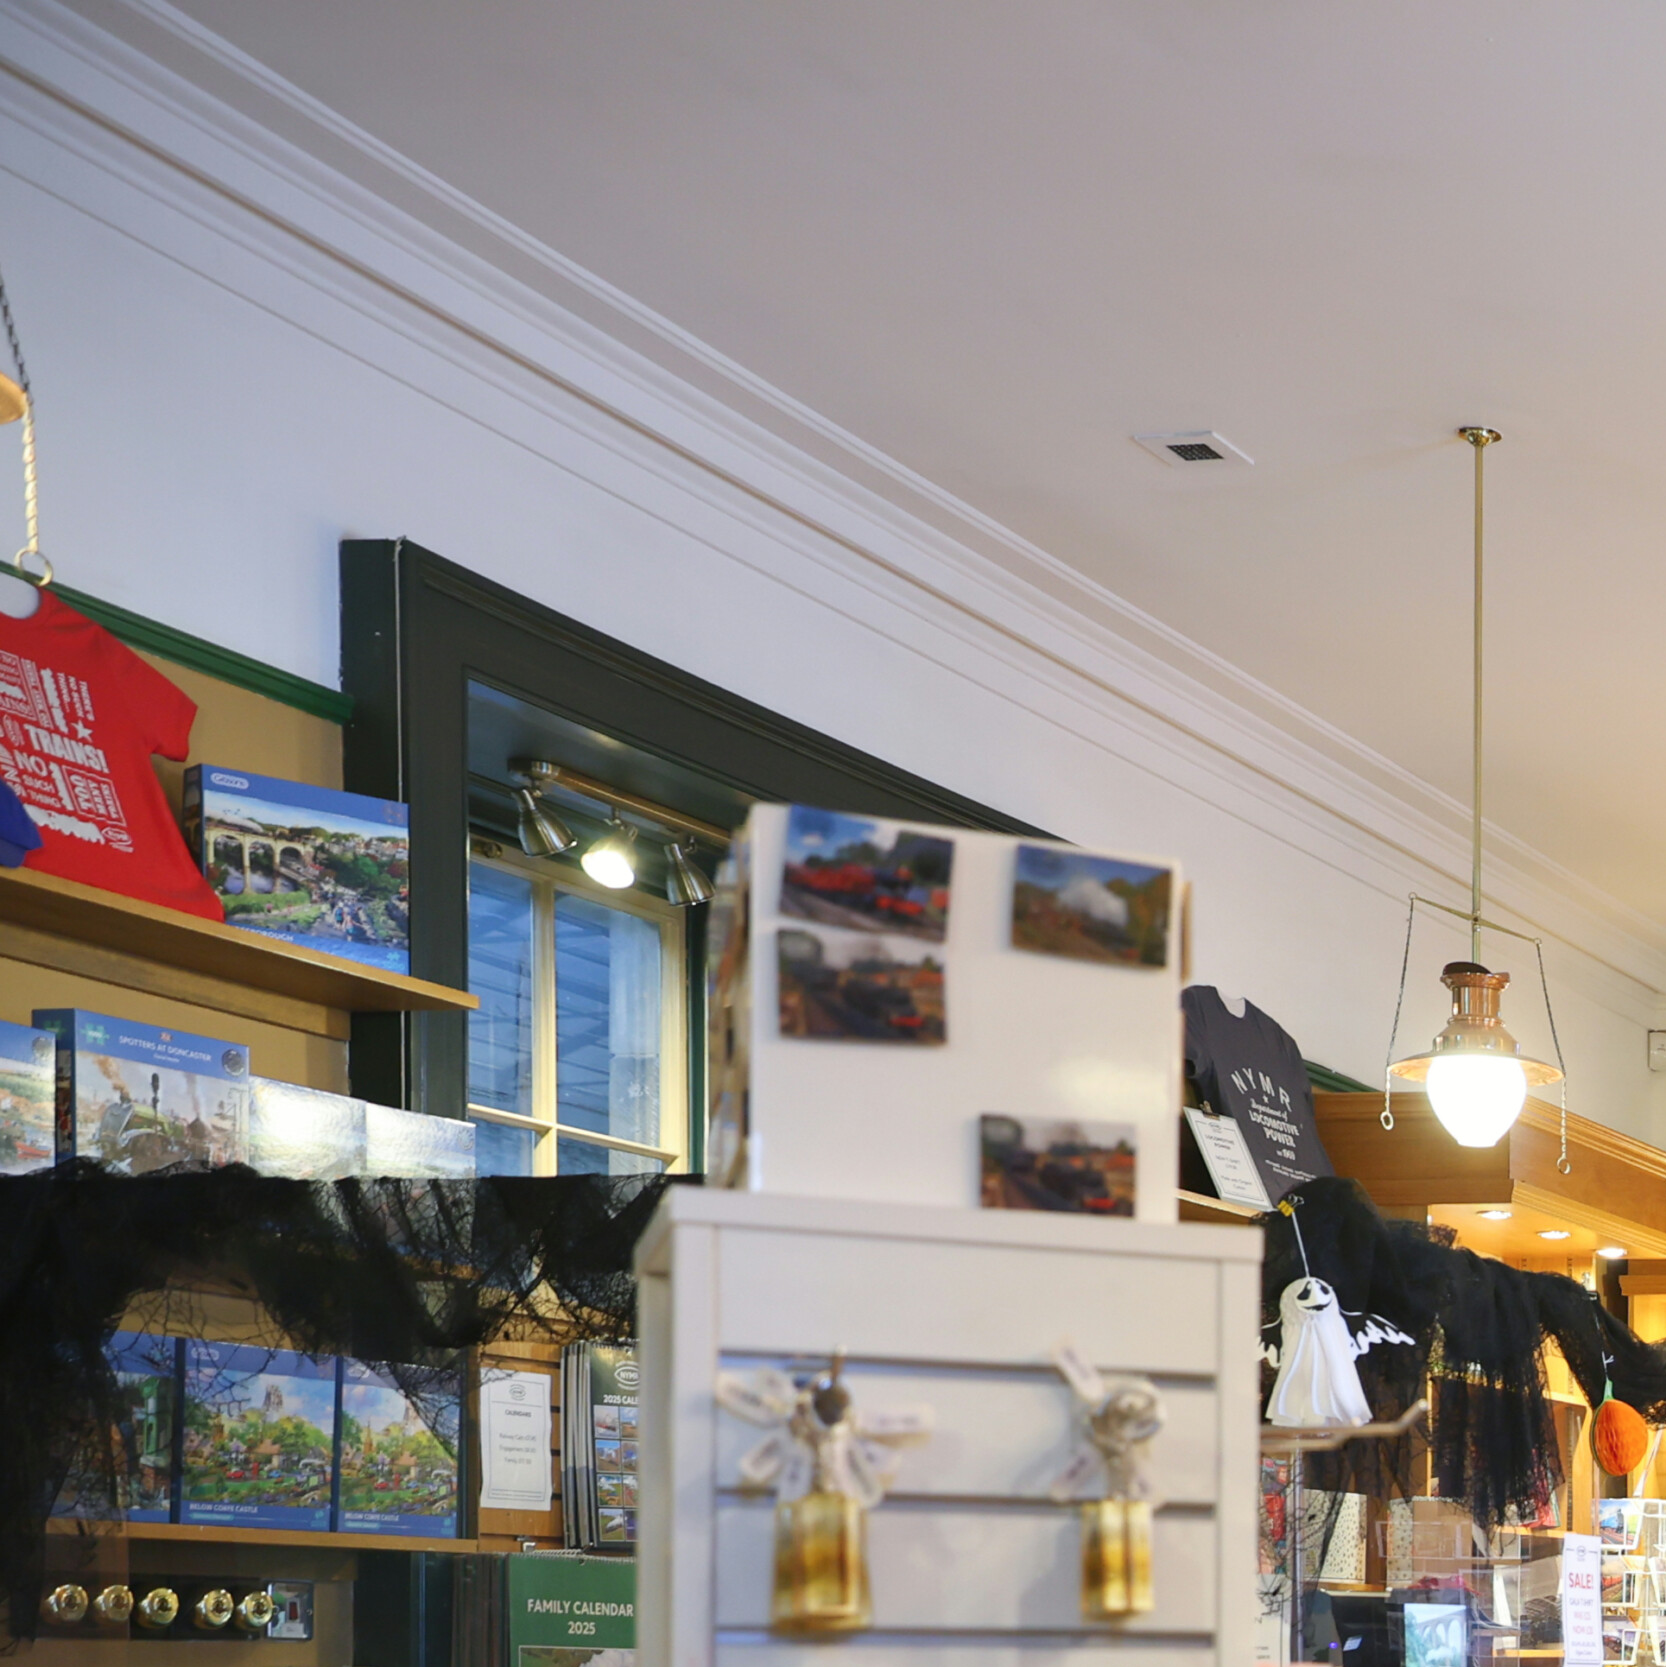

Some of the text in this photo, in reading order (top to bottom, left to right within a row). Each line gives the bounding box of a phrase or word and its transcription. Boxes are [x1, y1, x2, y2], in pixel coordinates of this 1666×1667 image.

[24, 723, 110, 774] TRAINS!
[14, 750, 47, 777] NO
[119, 1035, 156, 1051] SPOTTERS
[167, 1045, 212, 1062] DONCASTER
[1231, 1067, 1293, 1113] NYMR
[1248, 1109, 1300, 1137] LOCOMOTIVE
[1263, 1126, 1297, 1148] POWER
[1568, 1572, 1594, 1590] SALE!
[527, 1599, 635, 1617] FAMILY CALENDAR
[567, 1621, 597, 1635] 2025
